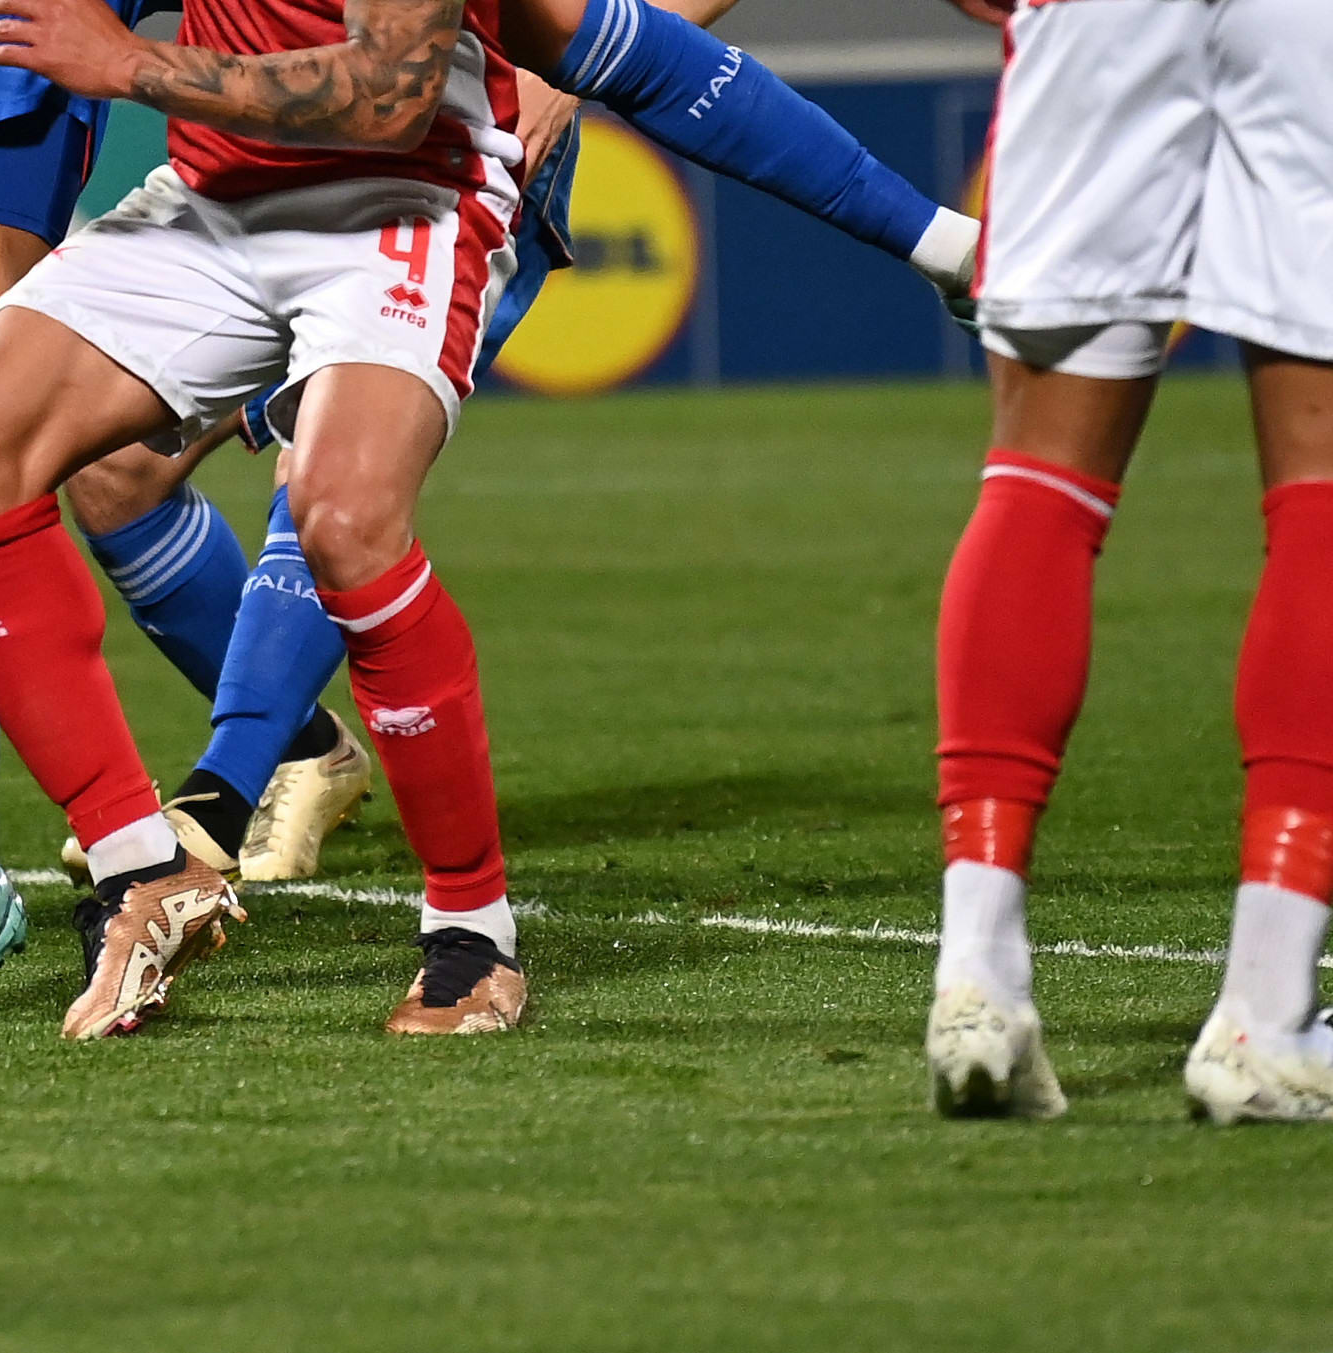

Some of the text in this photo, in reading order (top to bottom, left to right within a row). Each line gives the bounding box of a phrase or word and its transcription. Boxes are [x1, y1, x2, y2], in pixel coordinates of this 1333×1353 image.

[687, 45, 743, 119] ITALIA
[378, 215, 431, 285] 4
[380, 305, 427, 329] errea
